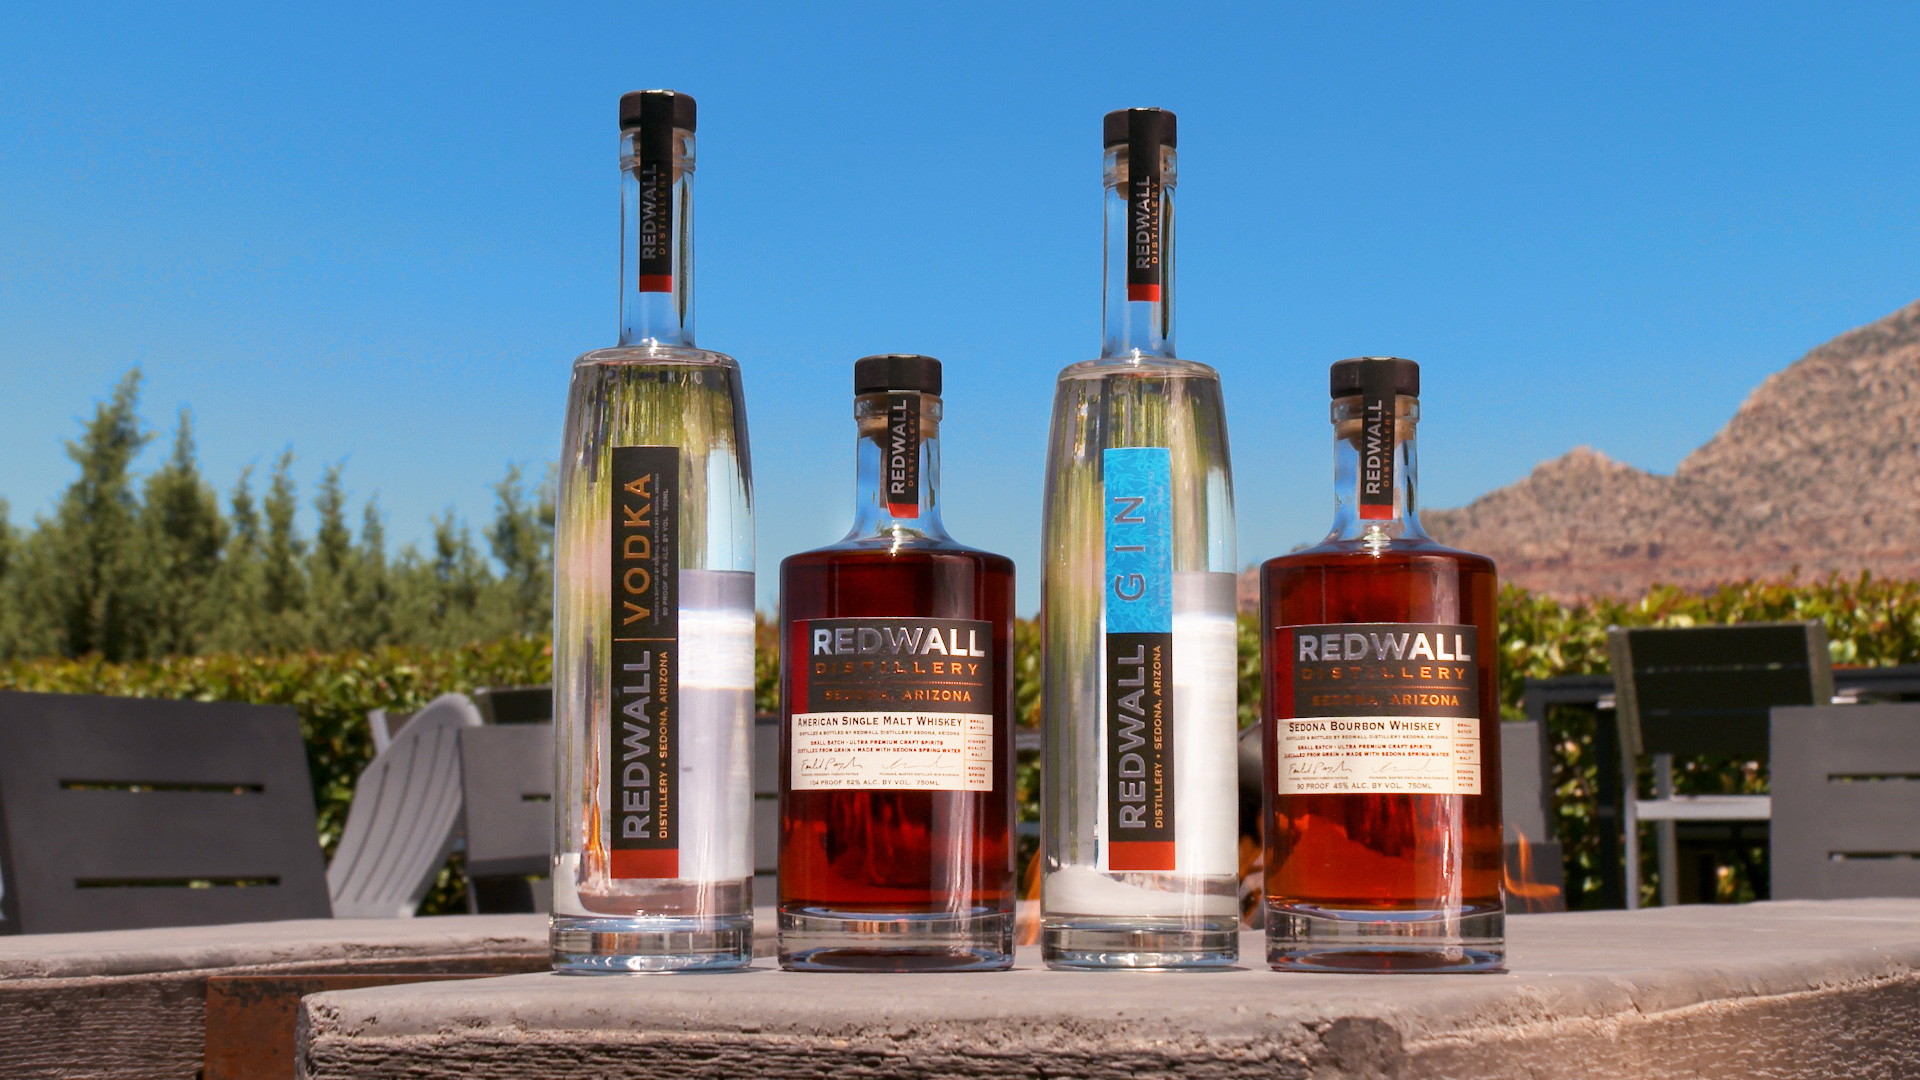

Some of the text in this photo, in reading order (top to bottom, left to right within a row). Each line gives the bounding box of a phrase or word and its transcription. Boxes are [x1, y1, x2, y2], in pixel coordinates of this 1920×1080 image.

[642, 164, 657, 259] REDWALL
[658, 172, 666, 255] DISTILLERY
[1135, 175, 1150, 269] REDWALL
[1151, 182, 1159, 264] DISTILLERY
[891, 399, 907, 494] REDWALL
[908, 409, 916, 487] DISTILLERY
[1366, 399, 1382, 494] REDWALL
[1383, 409, 1391, 488] DISTILLERY
[623, 473, 651, 626] VODKA
[662, 533, 669, 542] BY
[1113, 496, 1146, 602] GIN
[813, 627, 985, 657] REDWALL
[815, 661, 979, 676] DISTILLERY
[1299, 632, 1472, 662] REDWALL
[1302, 666, 1466, 680] DISTILLERY
[798, 716, 962, 727] AMERICAN SINGLE MALT WHISKEY
[904, 689, 972, 702] ARIZONA
[1118, 644, 1146, 828] REDWALL
[1152, 645, 1164, 828] DISTILLERY SEDONA, ARIZONA
[1289, 720, 1441, 732] SEDONA BOURBON WHISKEY
[1390, 694, 1460, 707] ARIZONA
[623, 650, 651, 839] REDWALL
[658, 651, 668, 839] DISTILLERY SEDONA, ARIZONA
